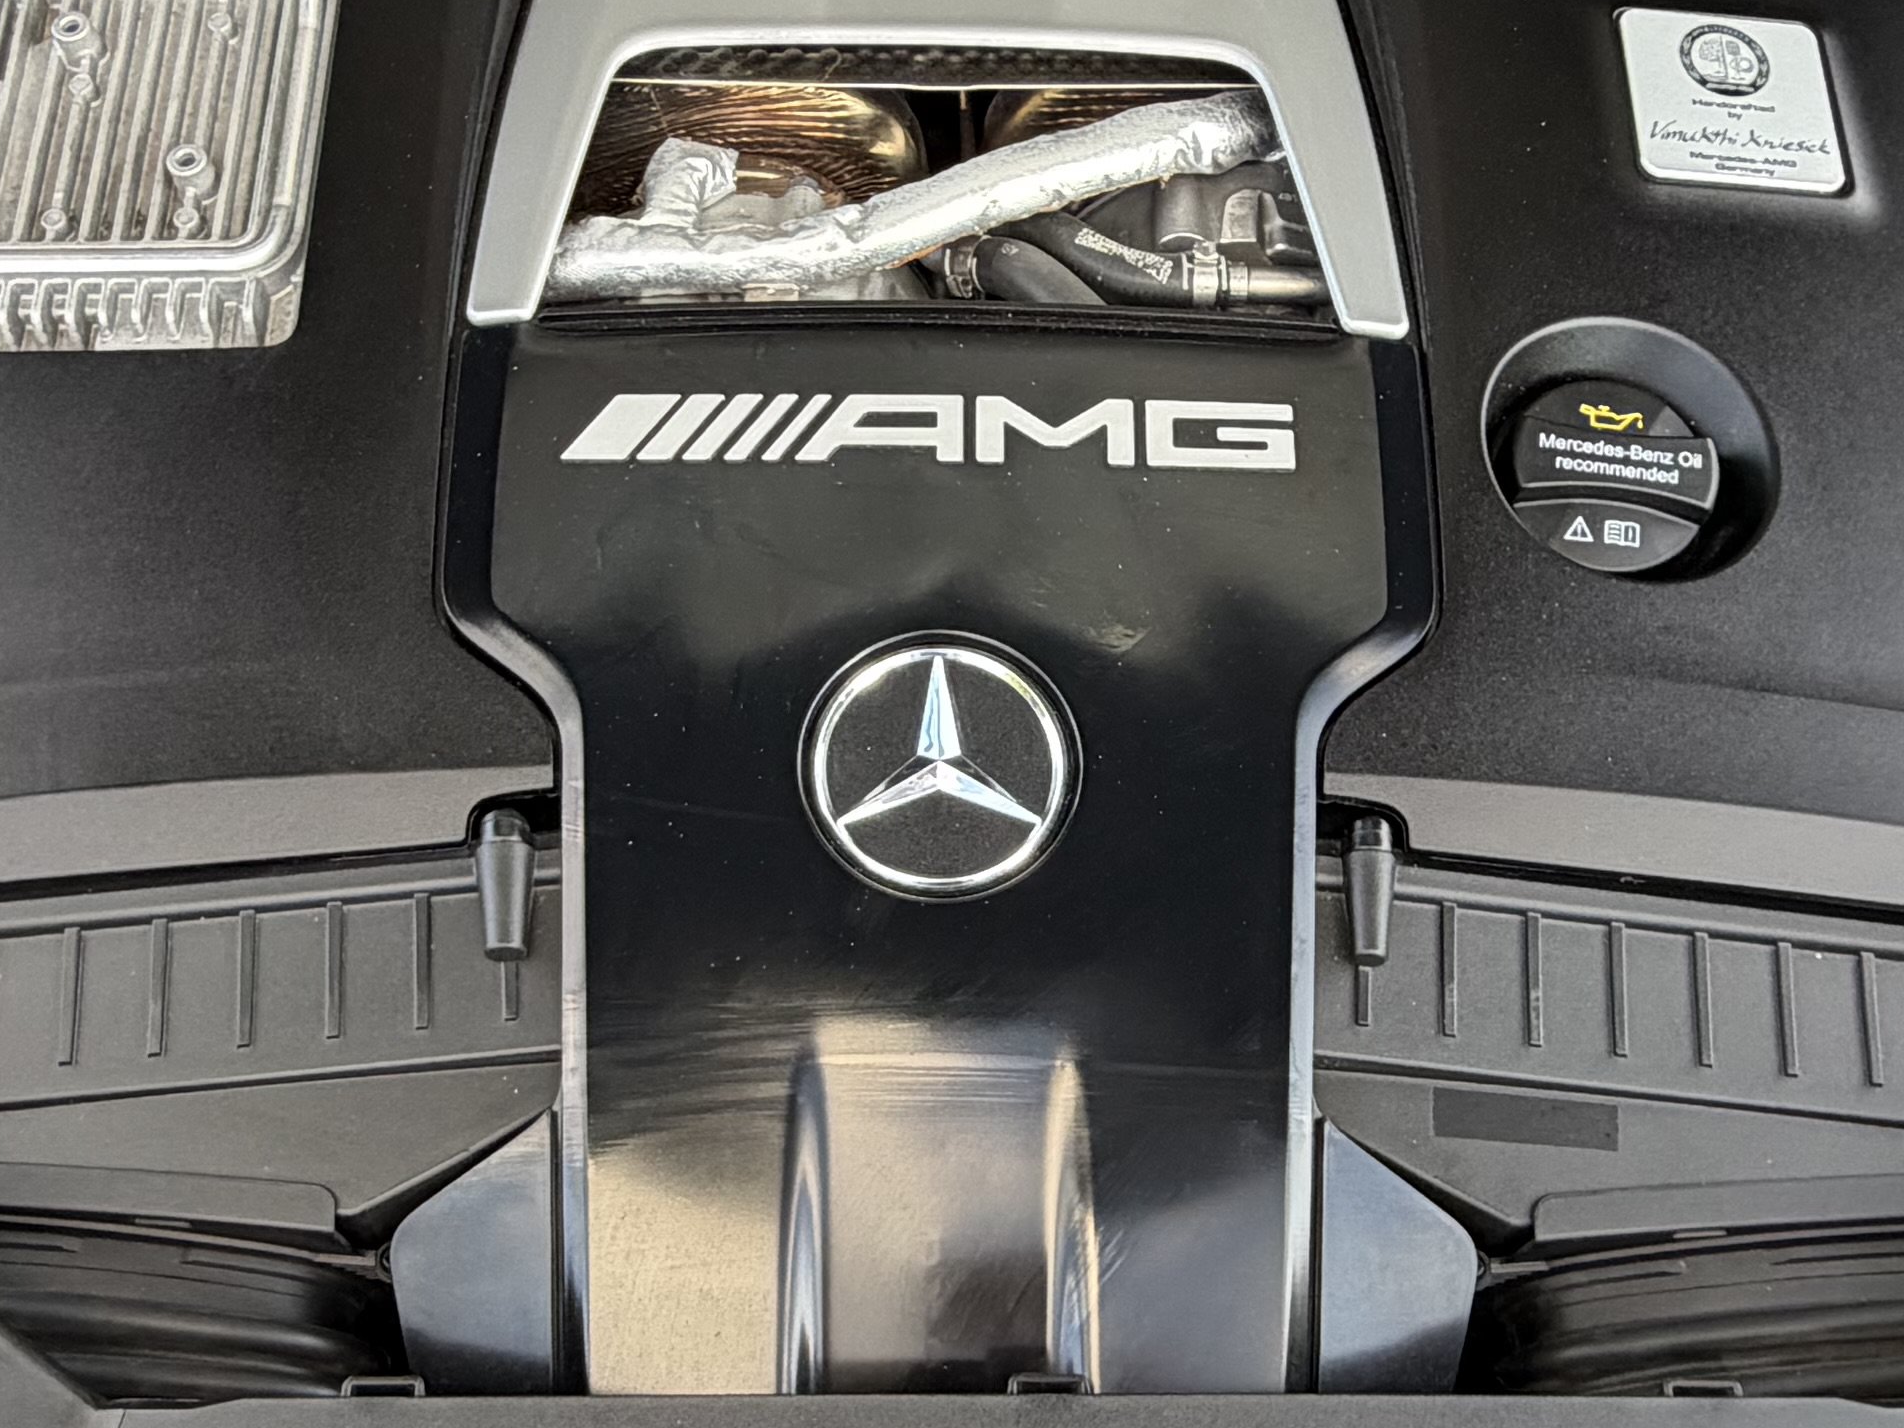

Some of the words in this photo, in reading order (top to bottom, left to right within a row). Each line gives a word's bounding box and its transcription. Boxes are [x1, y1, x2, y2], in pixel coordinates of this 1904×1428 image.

[1692, 98, 1776, 113] Handcrafted
[1727, 110, 1743, 121] by
[1689, 150, 1798, 168] Mercedes-AMG
[1715, 162, 1775, 177] Germany
[794, 392, 1296, 469] AMG
[1538, 432, 1675, 466] Mercedes-Benz
[1677, 451, 1704, 469] Oil
[1554, 455, 1680, 485] recommended
